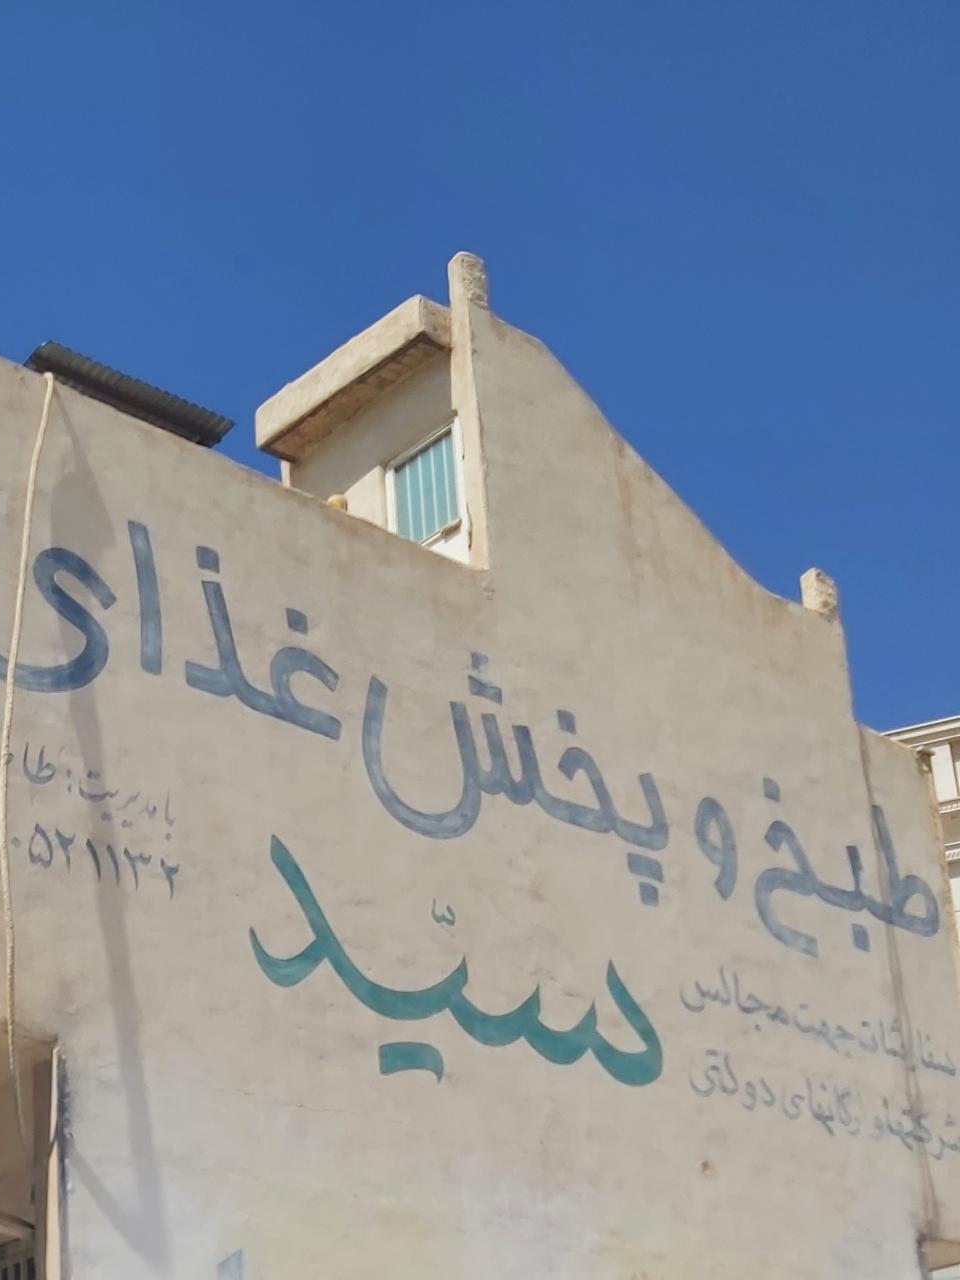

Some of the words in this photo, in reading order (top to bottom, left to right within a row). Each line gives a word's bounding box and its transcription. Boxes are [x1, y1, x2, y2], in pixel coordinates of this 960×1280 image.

[362, 652, 670, 908] پخش
[694, 796, 739, 901] و
[754, 777, 940, 958] طبخ
[680, 965, 790, 1032] مجالس
[689, 1048, 777, 1111] دولتی
